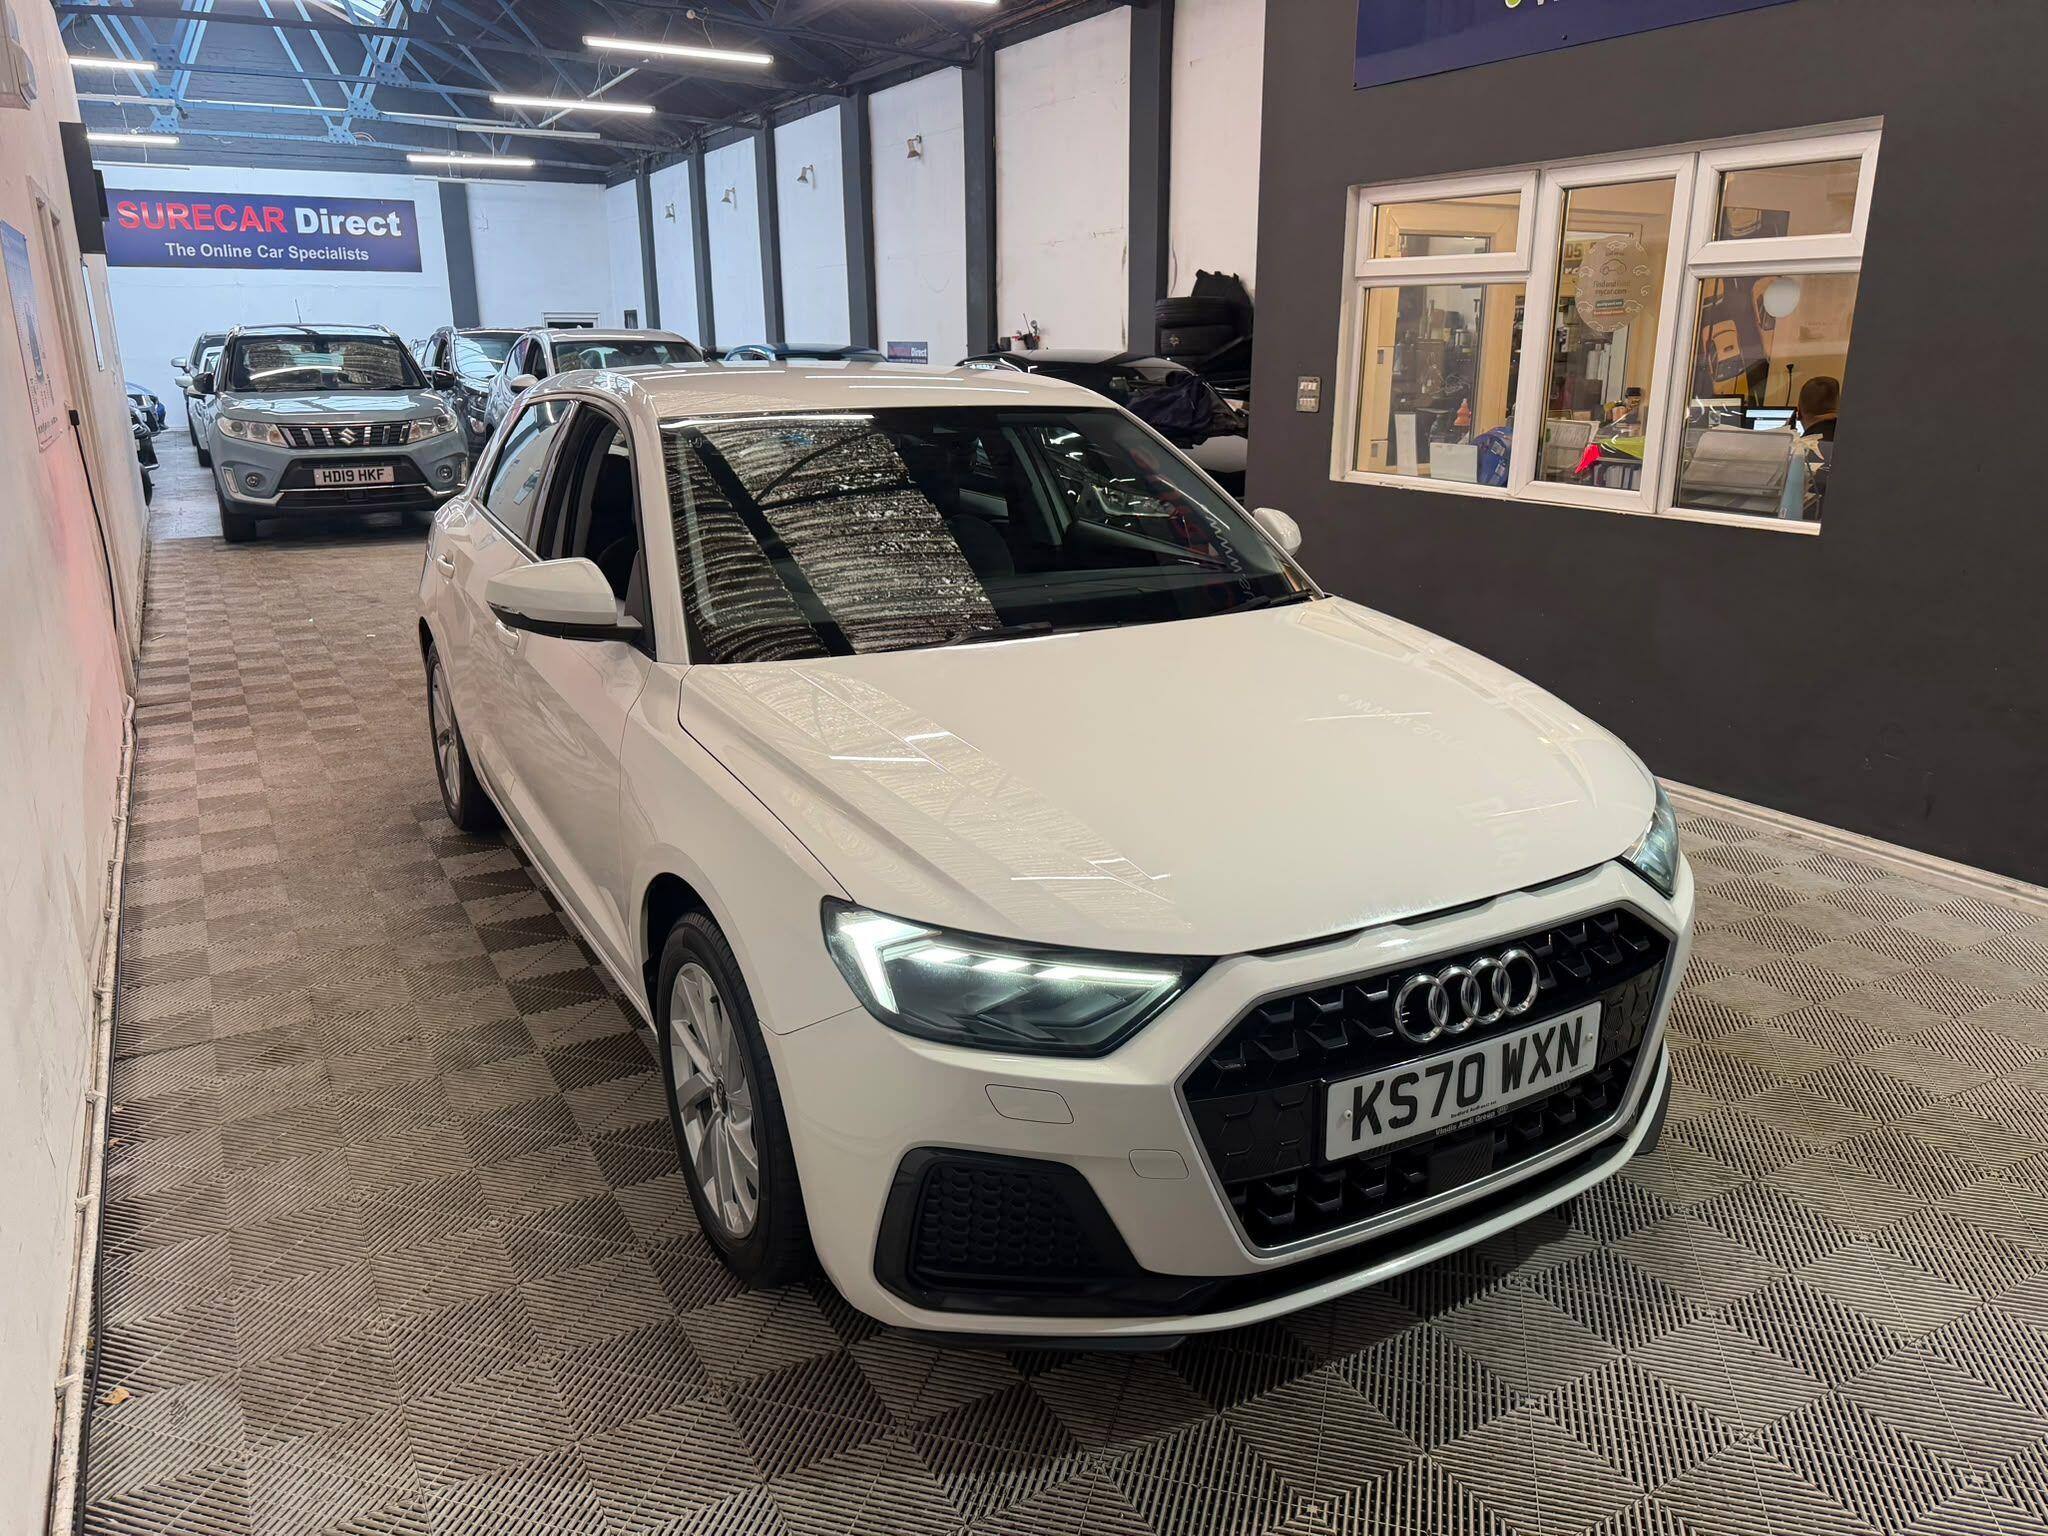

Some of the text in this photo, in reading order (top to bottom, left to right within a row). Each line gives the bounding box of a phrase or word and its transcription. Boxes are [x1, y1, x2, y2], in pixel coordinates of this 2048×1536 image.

[116, 200, 402, 236] SURECAR Direct
[165, 242, 369, 261] The Online Car Specialists
[322, 468, 385, 483] HD19 HKF
[1351, 1016, 1583, 1141] KS70 WXN
[1458, 1117, 1474, 1129] Audi
[1475, 1110, 1496, 1122] Group
